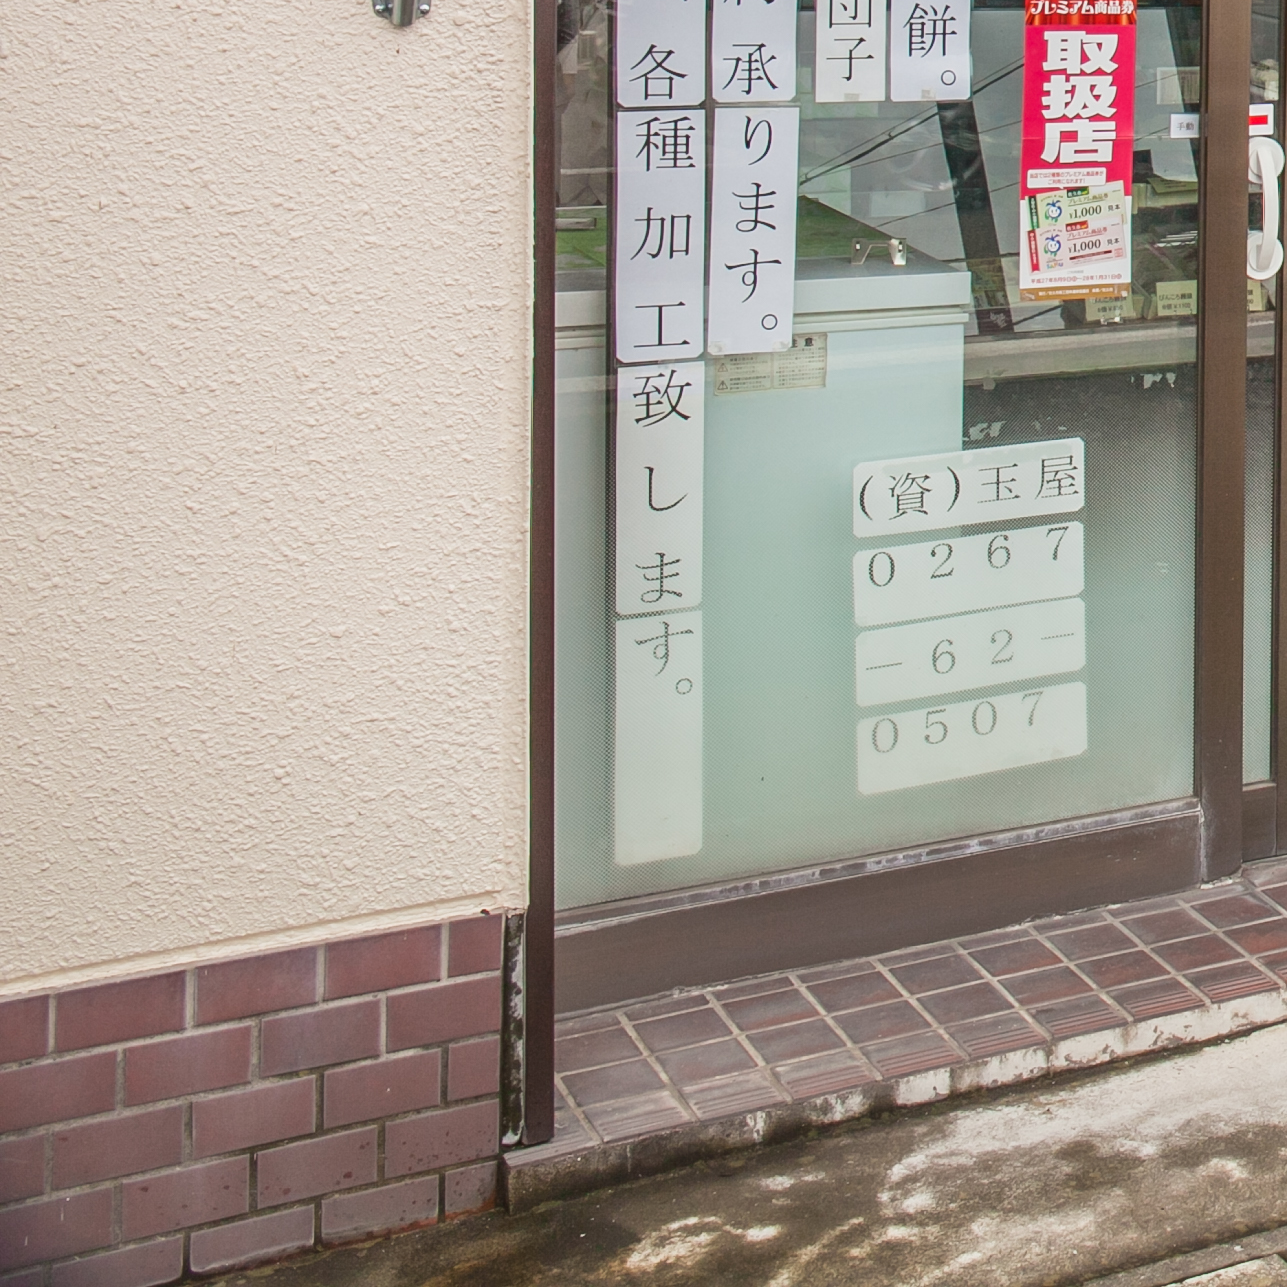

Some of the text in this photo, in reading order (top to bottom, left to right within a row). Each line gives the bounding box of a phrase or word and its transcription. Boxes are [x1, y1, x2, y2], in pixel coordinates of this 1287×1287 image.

[1030, 0, 1135, 15] プレミアム商品券
[1040, 30, 1119, 164] 取扱店
[1069, 205, 1102, 219] ¥1,000
[1068, 239, 1101, 253] ¥1,000
[867, 525, 1070, 589] 0267
[870, 691, 1045, 755] 0507
